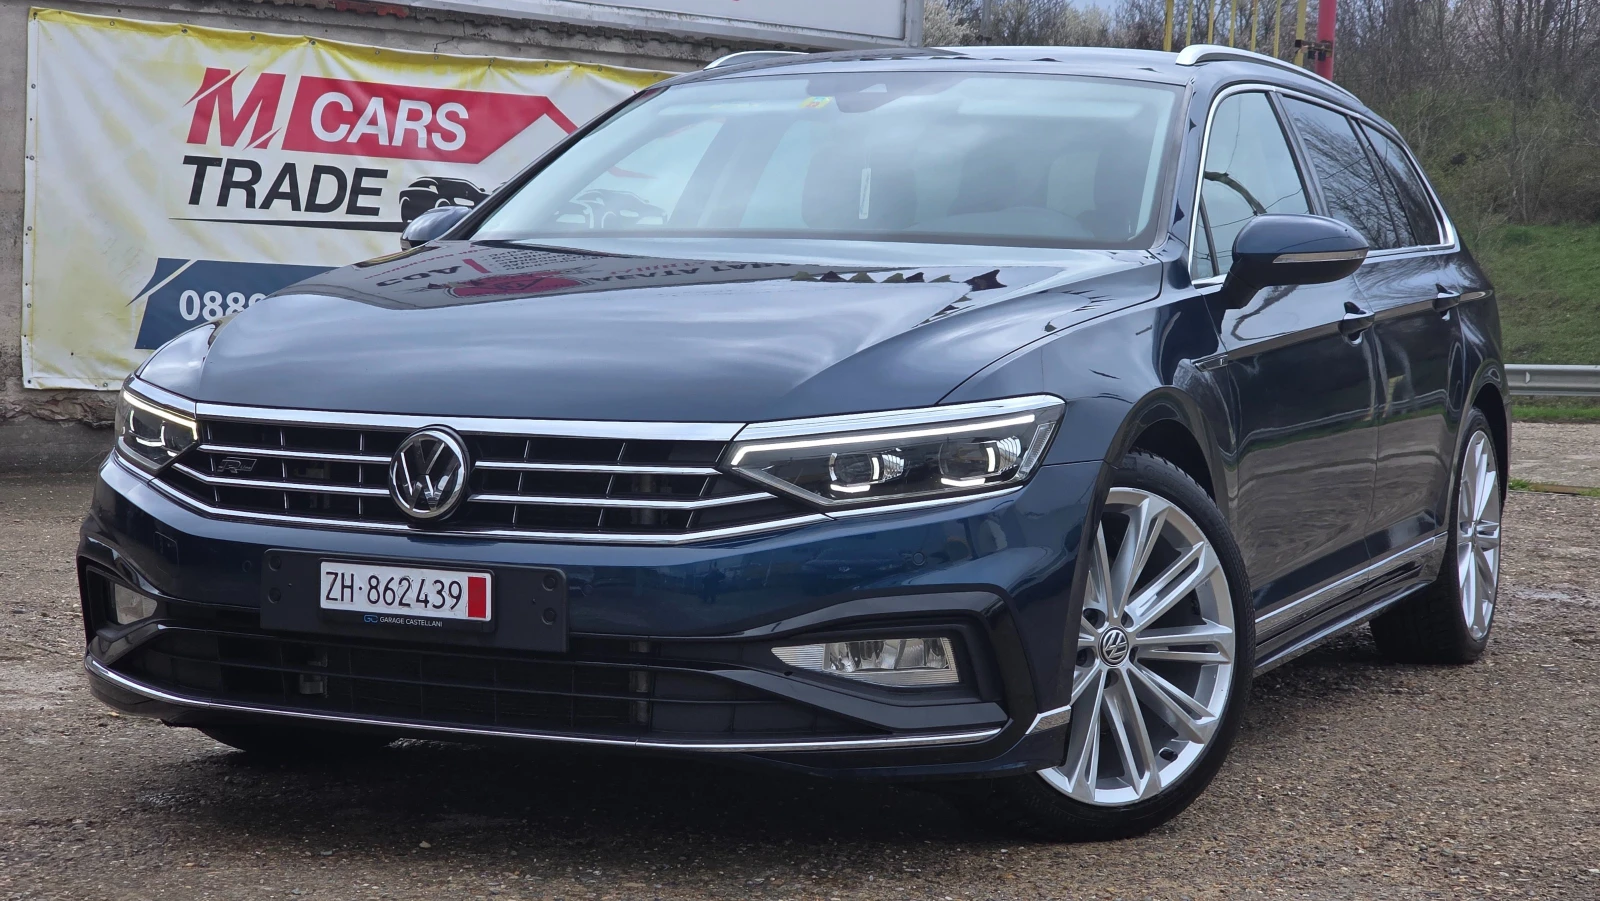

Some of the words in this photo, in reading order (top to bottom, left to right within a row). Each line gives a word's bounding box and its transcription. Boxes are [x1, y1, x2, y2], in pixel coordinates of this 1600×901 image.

[186, 67, 285, 149] M
[309, 91, 469, 151] CARS
[182, 155, 389, 217] TRADE
[379, 616, 405, 625] GARAGE
[405, 618, 443, 627] CASTELLANI
